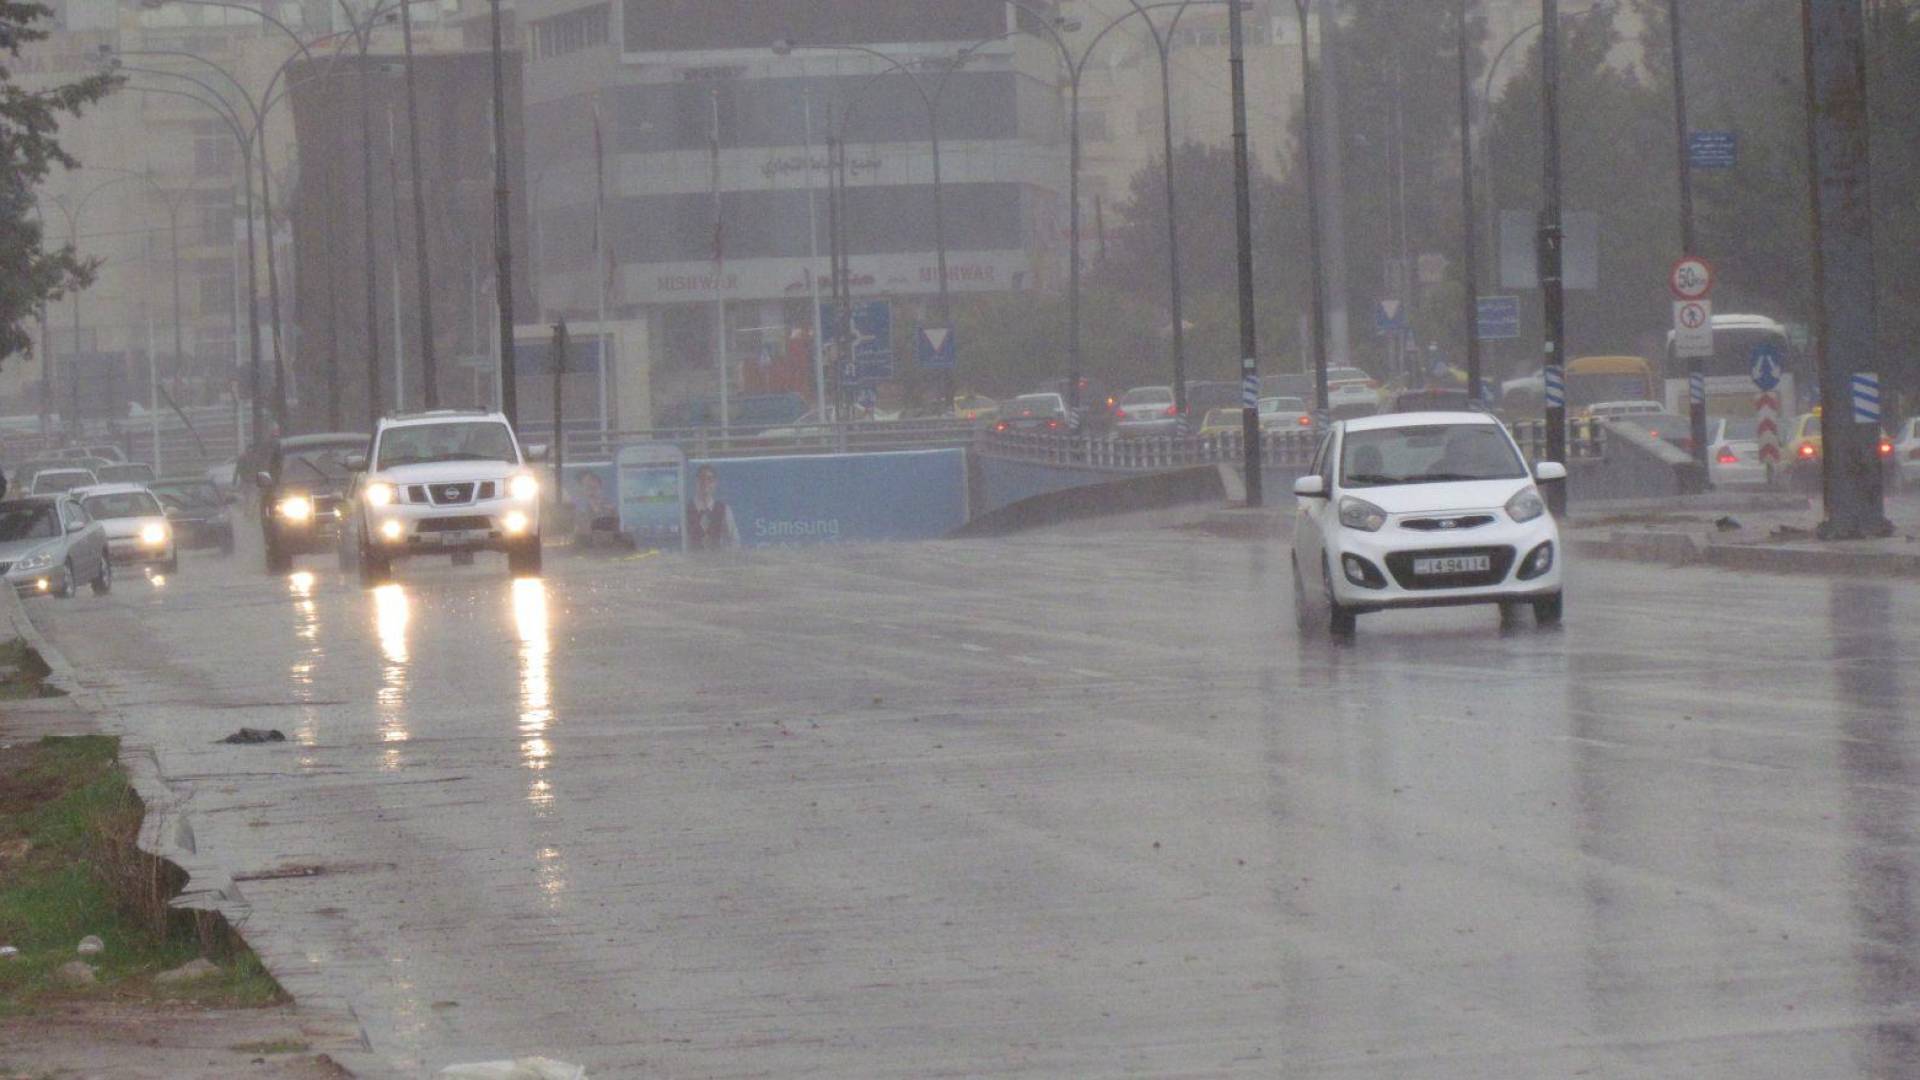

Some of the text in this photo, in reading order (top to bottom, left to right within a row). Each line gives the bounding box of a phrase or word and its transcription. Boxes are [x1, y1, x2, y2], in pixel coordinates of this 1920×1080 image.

[919, 264, 995, 282] MIHWAR
[1679, 266, 1695, 288] 50
[657, 275, 738, 292] MISHWAR
[754, 518, 839, 538] Samsung
